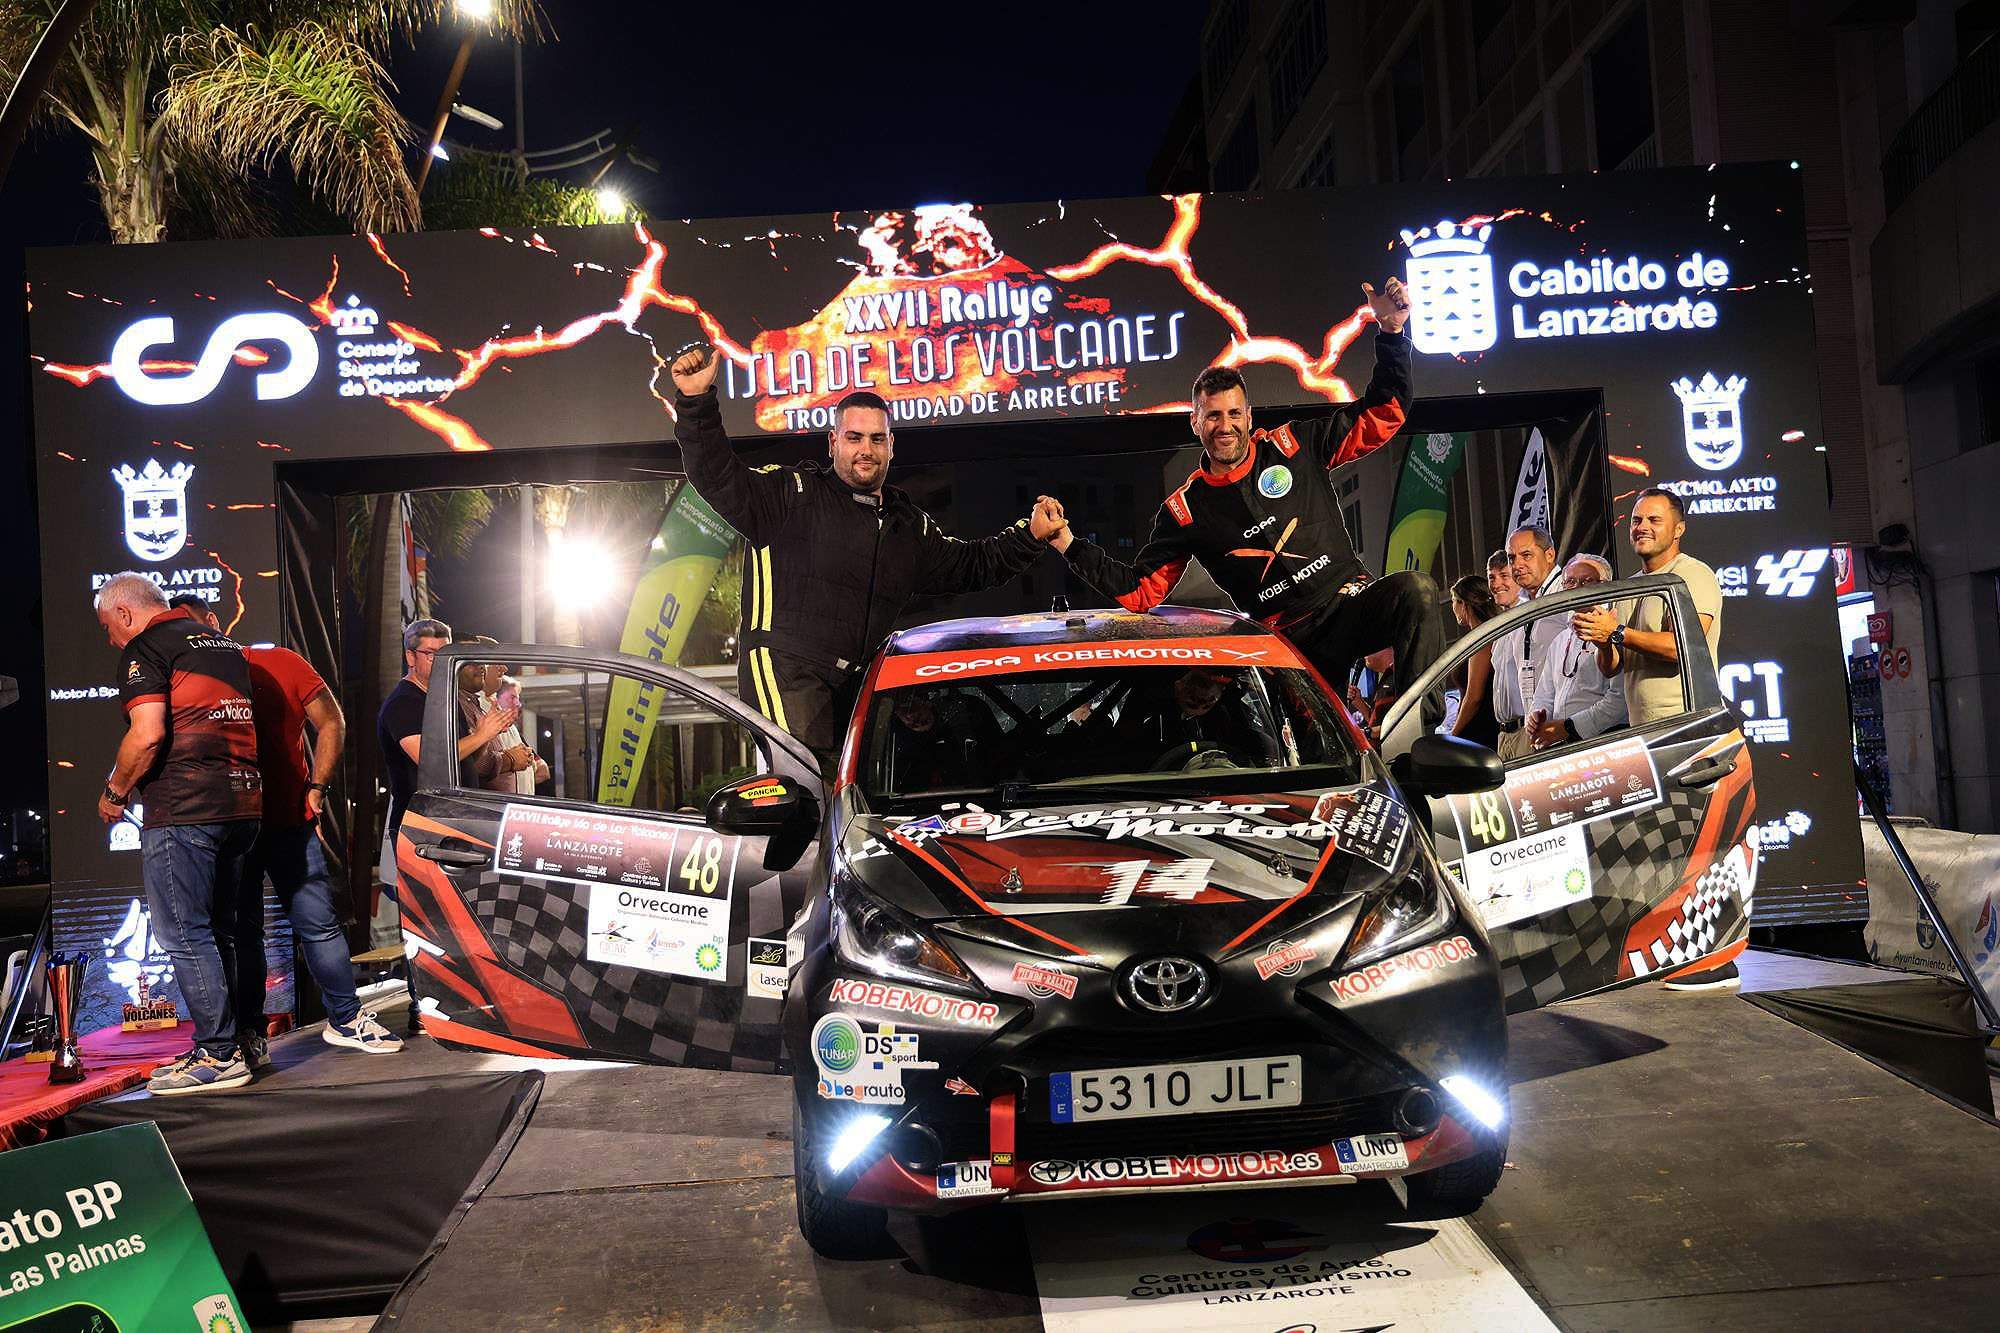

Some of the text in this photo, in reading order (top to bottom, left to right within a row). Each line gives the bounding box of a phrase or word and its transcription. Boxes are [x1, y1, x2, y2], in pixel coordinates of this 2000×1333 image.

[1508, 253, 1729, 298] Cabildo de
[844, 281, 1054, 334] XXVII Rallye
[1512, 296, 1718, 339] Lanzarote
[338, 338, 415, 358] Consejo
[725, 310, 1185, 400] ISLA DE LOS VOLCANES
[339, 360, 421, 380] Superior
[340, 378, 454, 399] de Deportes
[784, 381, 1121, 430] TRO IUDAD DE ARRECIFE
[1729, 477, 1777, 493] AYTO
[1688, 495, 1776, 514] ARRECIFE
[1243, 515, 1277, 539] COPA
[171, 568, 222, 586] AYTO
[1258, 554, 1332, 603] KOBE MOTOR
[915, 648, 1214, 677] COPA KOBEMOTOR
[50, 688, 88, 700] Motor
[607, 764, 623, 787] bp
[1550, 774, 1616, 801] LANZAROTE
[747, 787, 778, 797] PANCHI
[1469, 792, 1507, 844] 48
[546, 838, 624, 858] LANZAROTE
[1490, 835, 1567, 867] Orvecame
[679, 834, 723, 894] 48
[1100, 858, 1215, 905] 14
[618, 891, 710, 919] Orvecame
[1330, 936, 1477, 1001] KOBEMOTOR
[1894, 950, 1945, 971] Ayuntamiento
[830, 979, 999, 1025] KOBEMOTOR
[123, 1007, 176, 1023] VOLCANES
[819, 1048, 856, 1060] TUNAP
[865, 1036, 893, 1055] DS
[892, 1053, 917, 1063] sport
[1081, 1062, 1290, 1114] 5310 JLF
[1057, 1103, 1067, 1114] E
[993, 1155, 1012, 1164] OMP
[1357, 1138, 1398, 1157] UNO
[960, 1165, 993, 1183] UN
[1077, 1151, 1321, 1181] KOBEMOTOR.es
[66, 1180, 123, 1229] BP
[45, 1233, 147, 1281] Palmas
[1130, 1265, 1413, 1298] Cultura y Turismo
[1139, 1256, 1394, 1285] Centros de Arte,
[214, 1300, 228, 1312] bp
[1204, 1285, 1355, 1306] LANZAROTE
